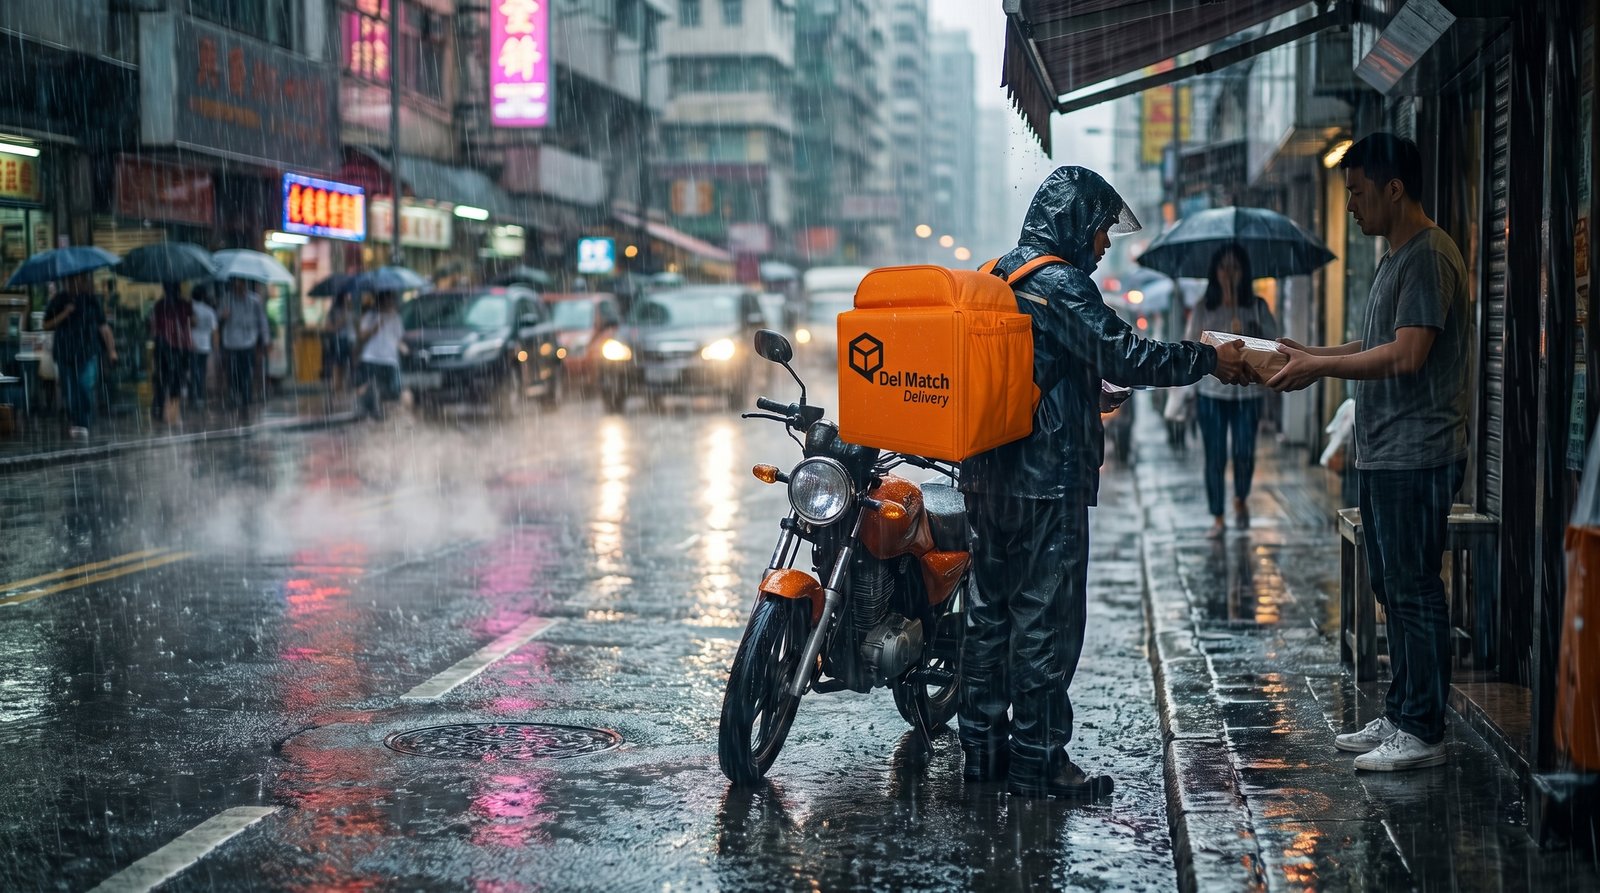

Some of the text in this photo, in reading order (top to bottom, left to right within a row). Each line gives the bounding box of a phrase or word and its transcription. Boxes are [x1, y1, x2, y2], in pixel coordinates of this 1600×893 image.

[879, 371, 950, 390] Del Match
[903, 390, 950, 408] Delivery
